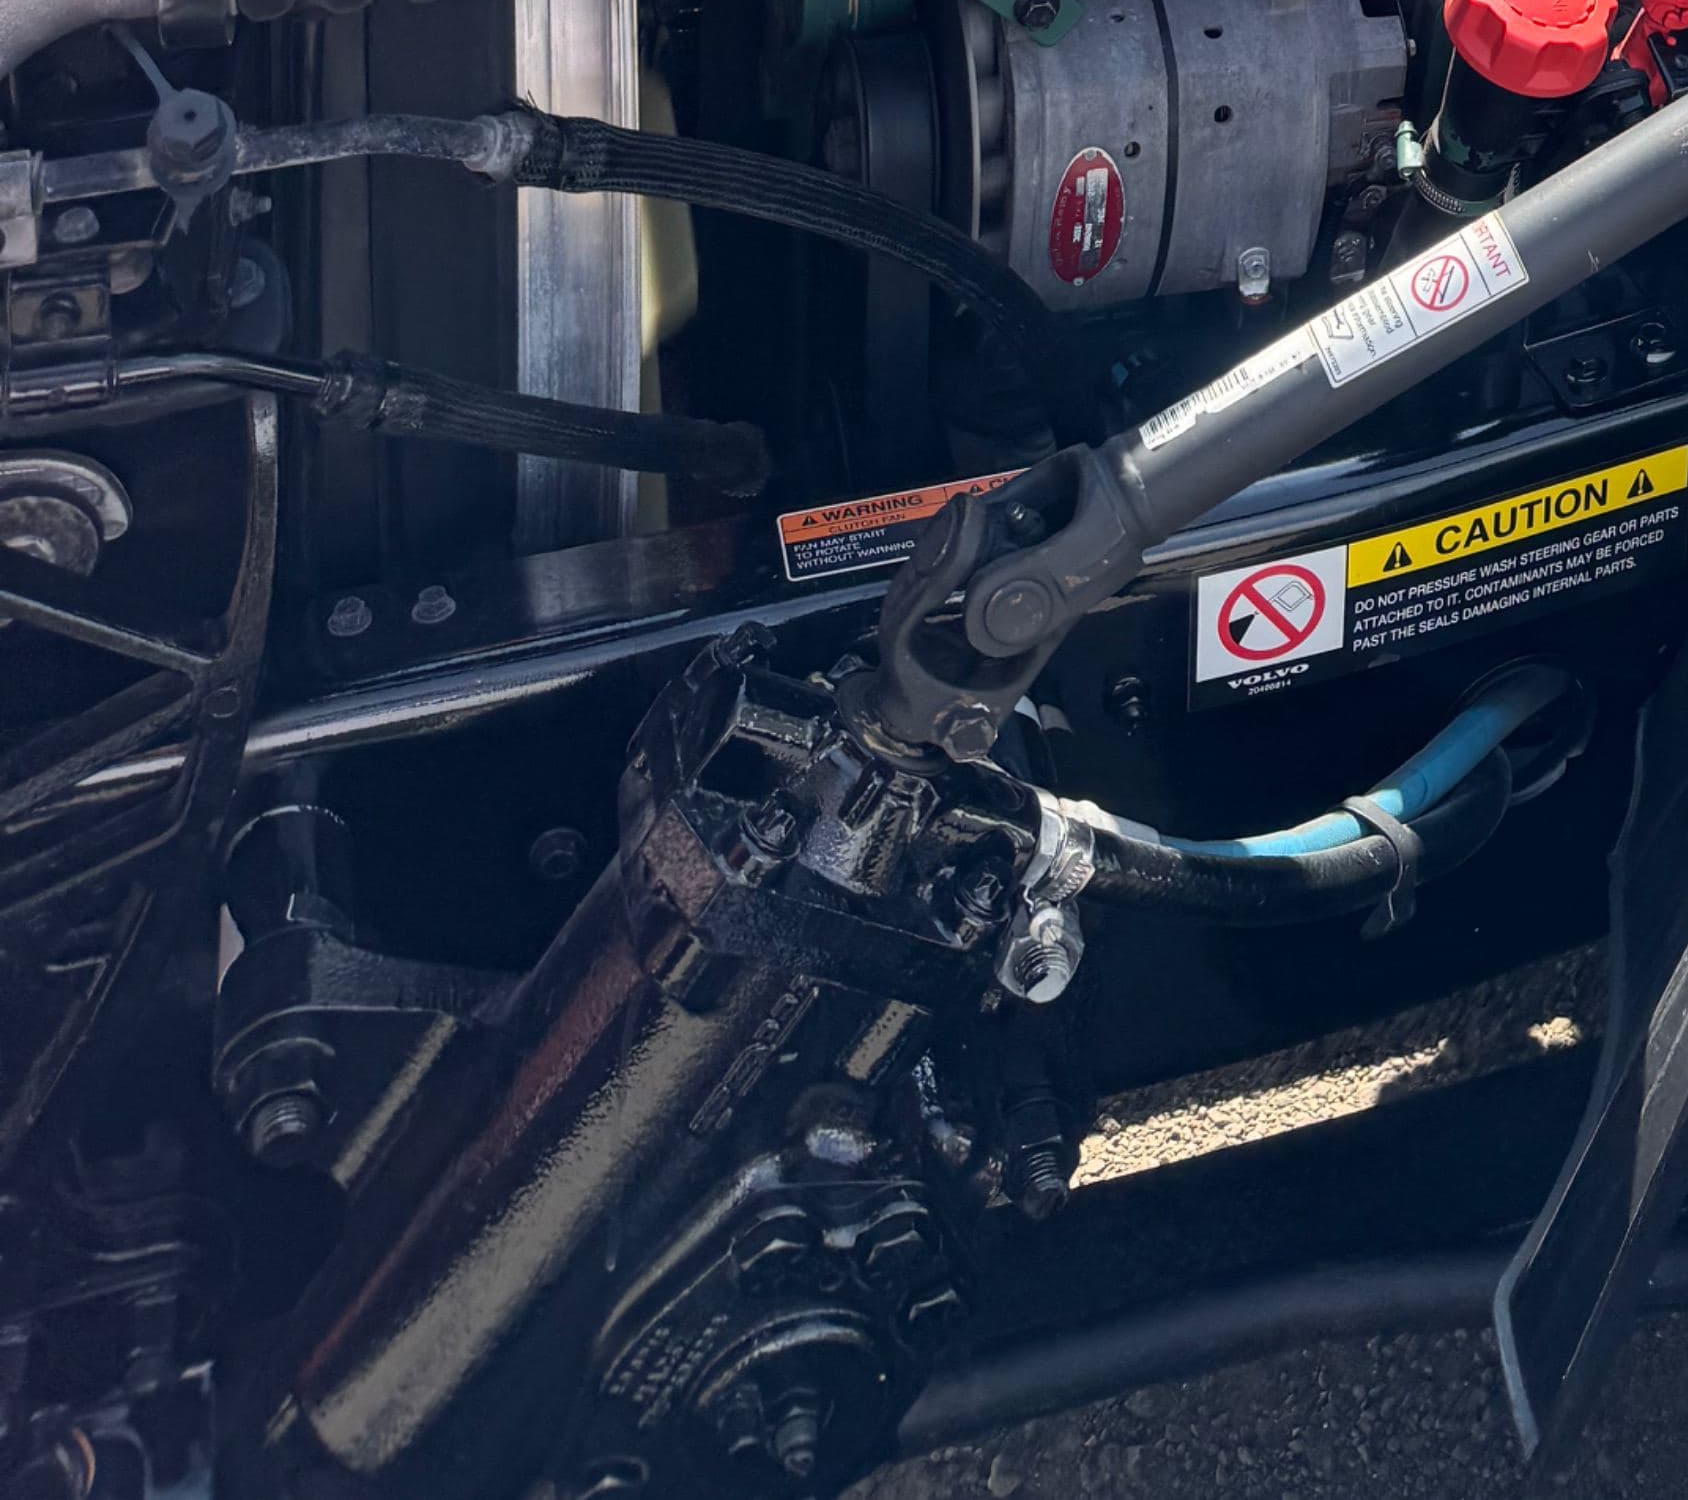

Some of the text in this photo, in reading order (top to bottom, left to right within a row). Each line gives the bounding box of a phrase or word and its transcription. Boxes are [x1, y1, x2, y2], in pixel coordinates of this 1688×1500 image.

[821, 494, 923, 522] WARNING
[1435, 478, 1608, 555] CAUTION
[827, 513, 906, 534] CLUTCH FAN
[793, 528, 887, 552] FAN MAY START
[796, 541, 861, 560] TO ROTATE
[797, 539, 916, 570] WITHOUT WARNING
[1354, 506, 1679, 614] DO NOT PRESSURE WASH STEERING GEAR OR PARTS
[1353, 529, 1665, 634] ATTACHED TO IT. CONTAMINANTS MAY BE FORCED
[1352, 556, 1637, 652] PAST THE SEALS DAMAGING INTERNAL PARTS.
[1227, 663, 1310, 689] VOLVO
